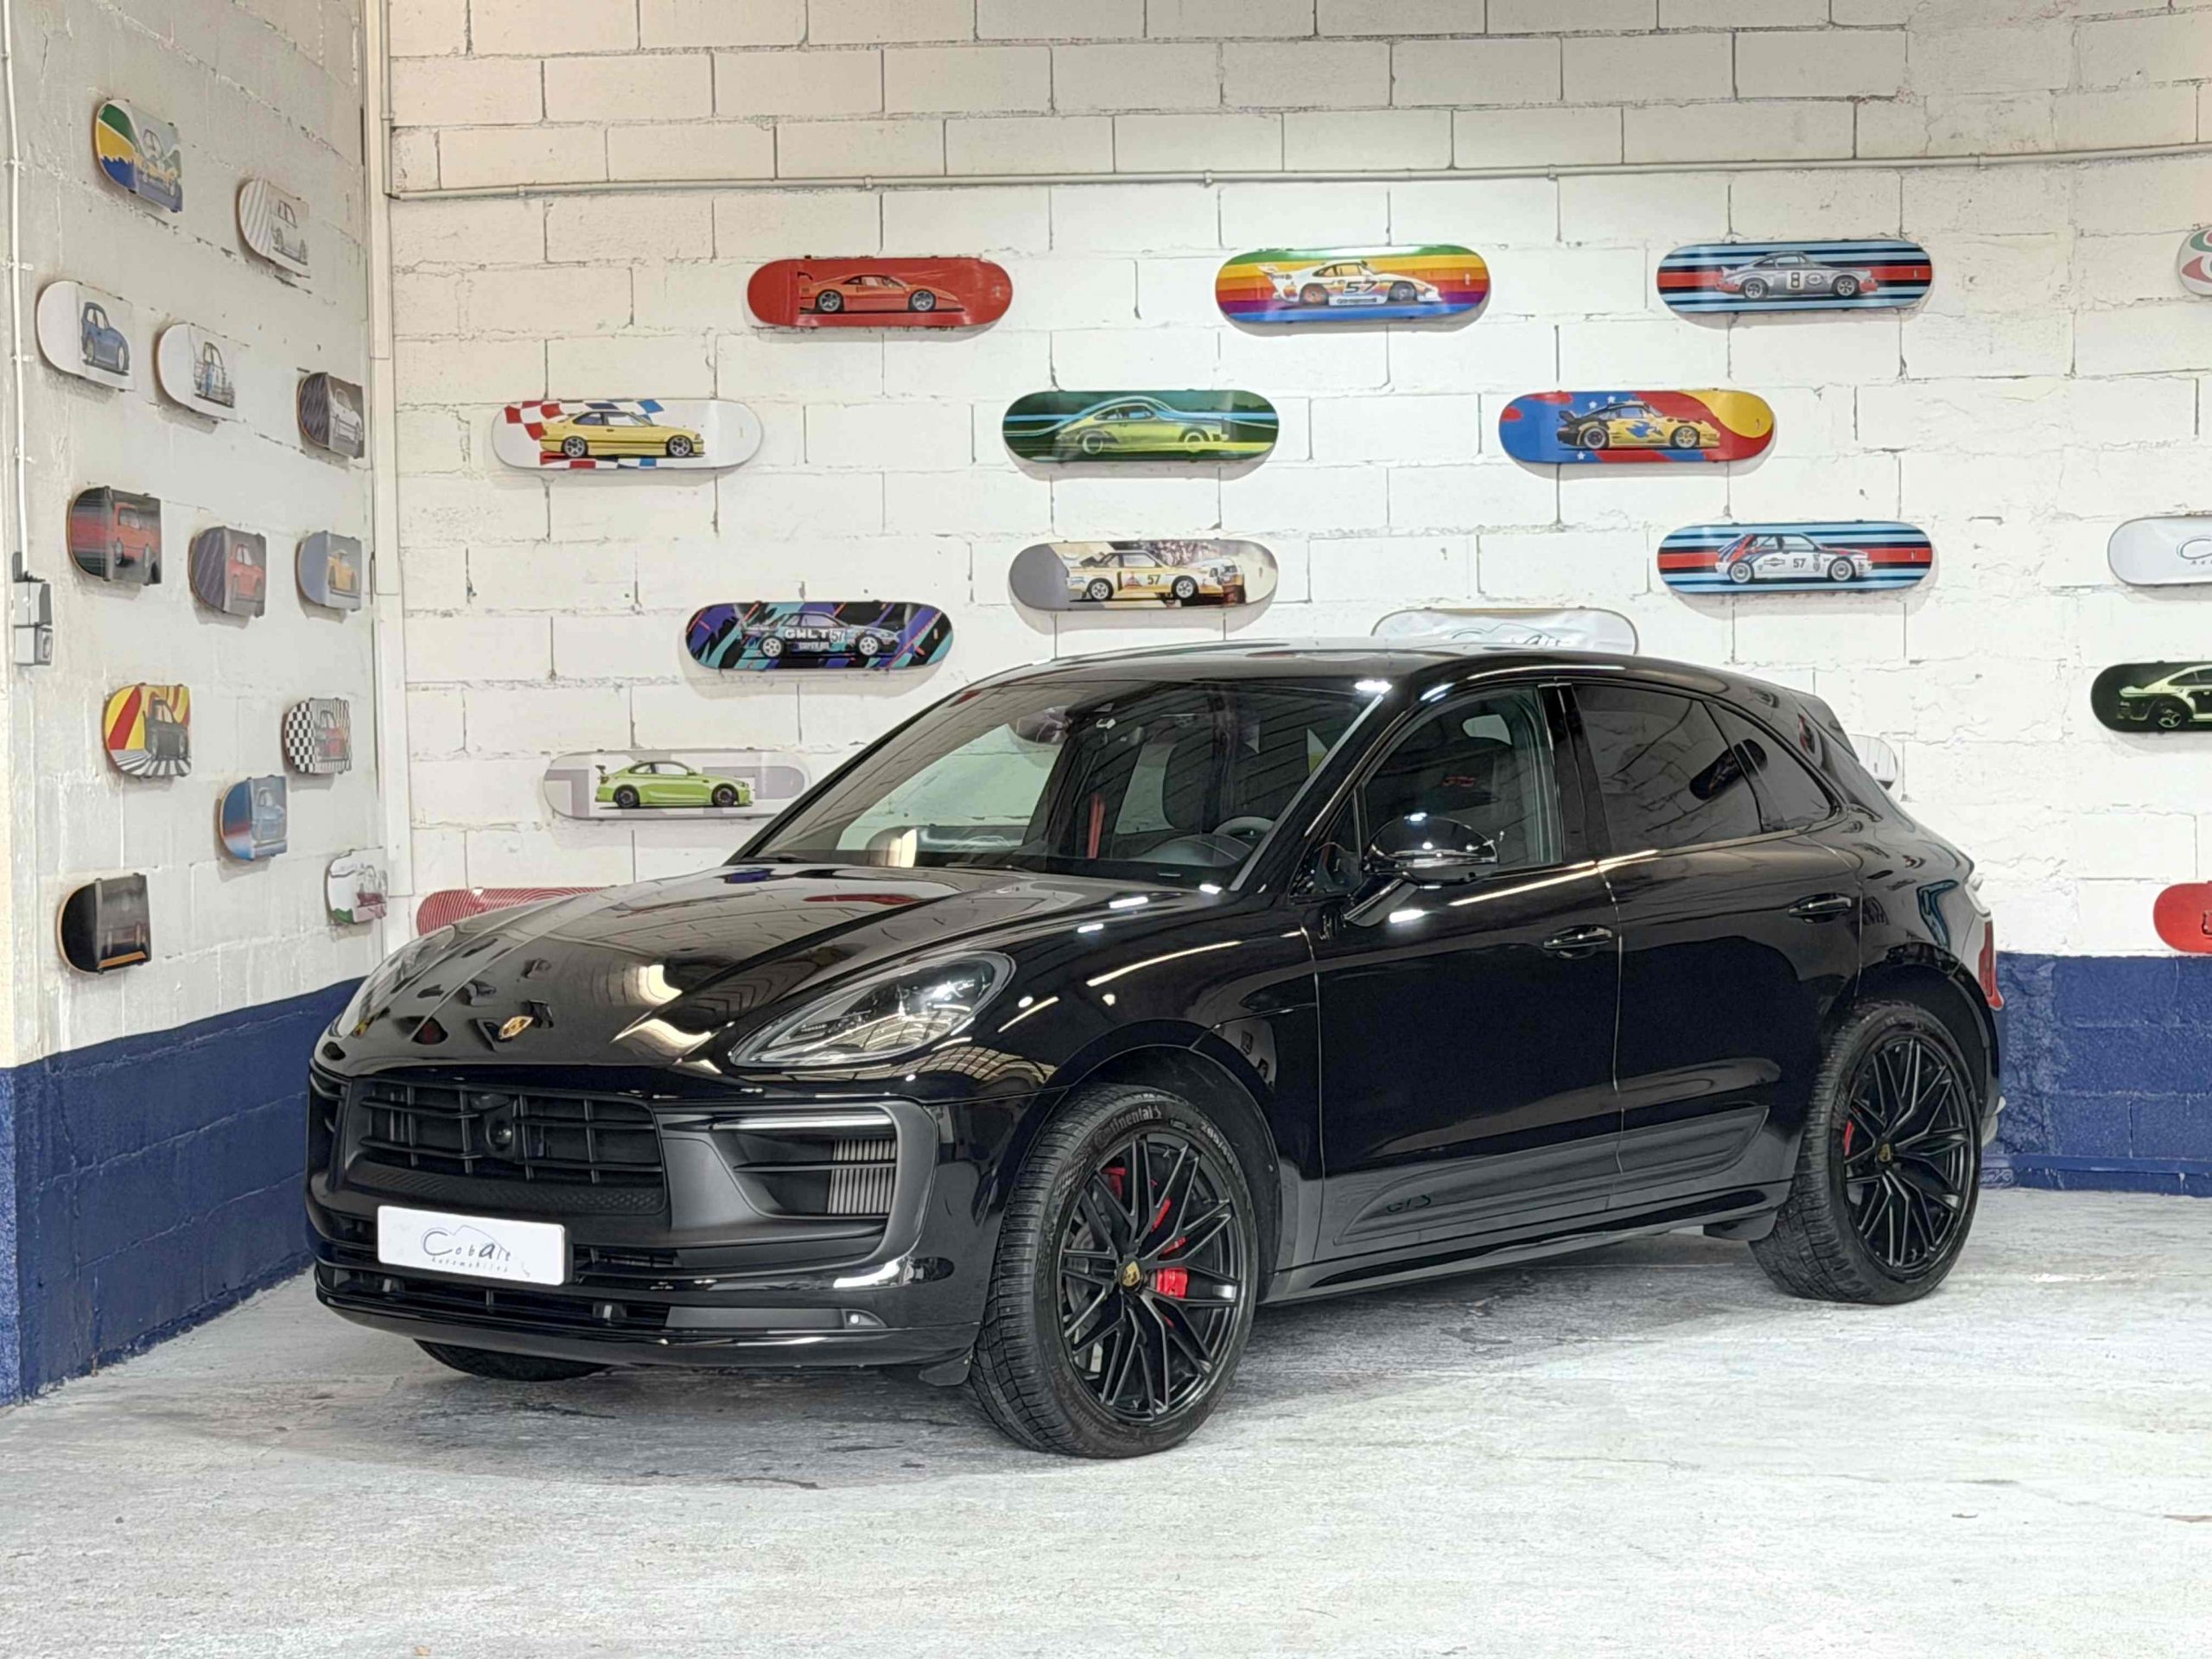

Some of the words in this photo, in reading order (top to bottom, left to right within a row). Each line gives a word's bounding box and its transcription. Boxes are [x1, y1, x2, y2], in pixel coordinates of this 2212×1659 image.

[1790, 271, 1801, 289] 8
[1344, 281, 1377, 294] 57
[1793, 557, 1806, 569] 57
[1147, 574, 1161, 586] 57
[831, 629, 843, 642] 57
